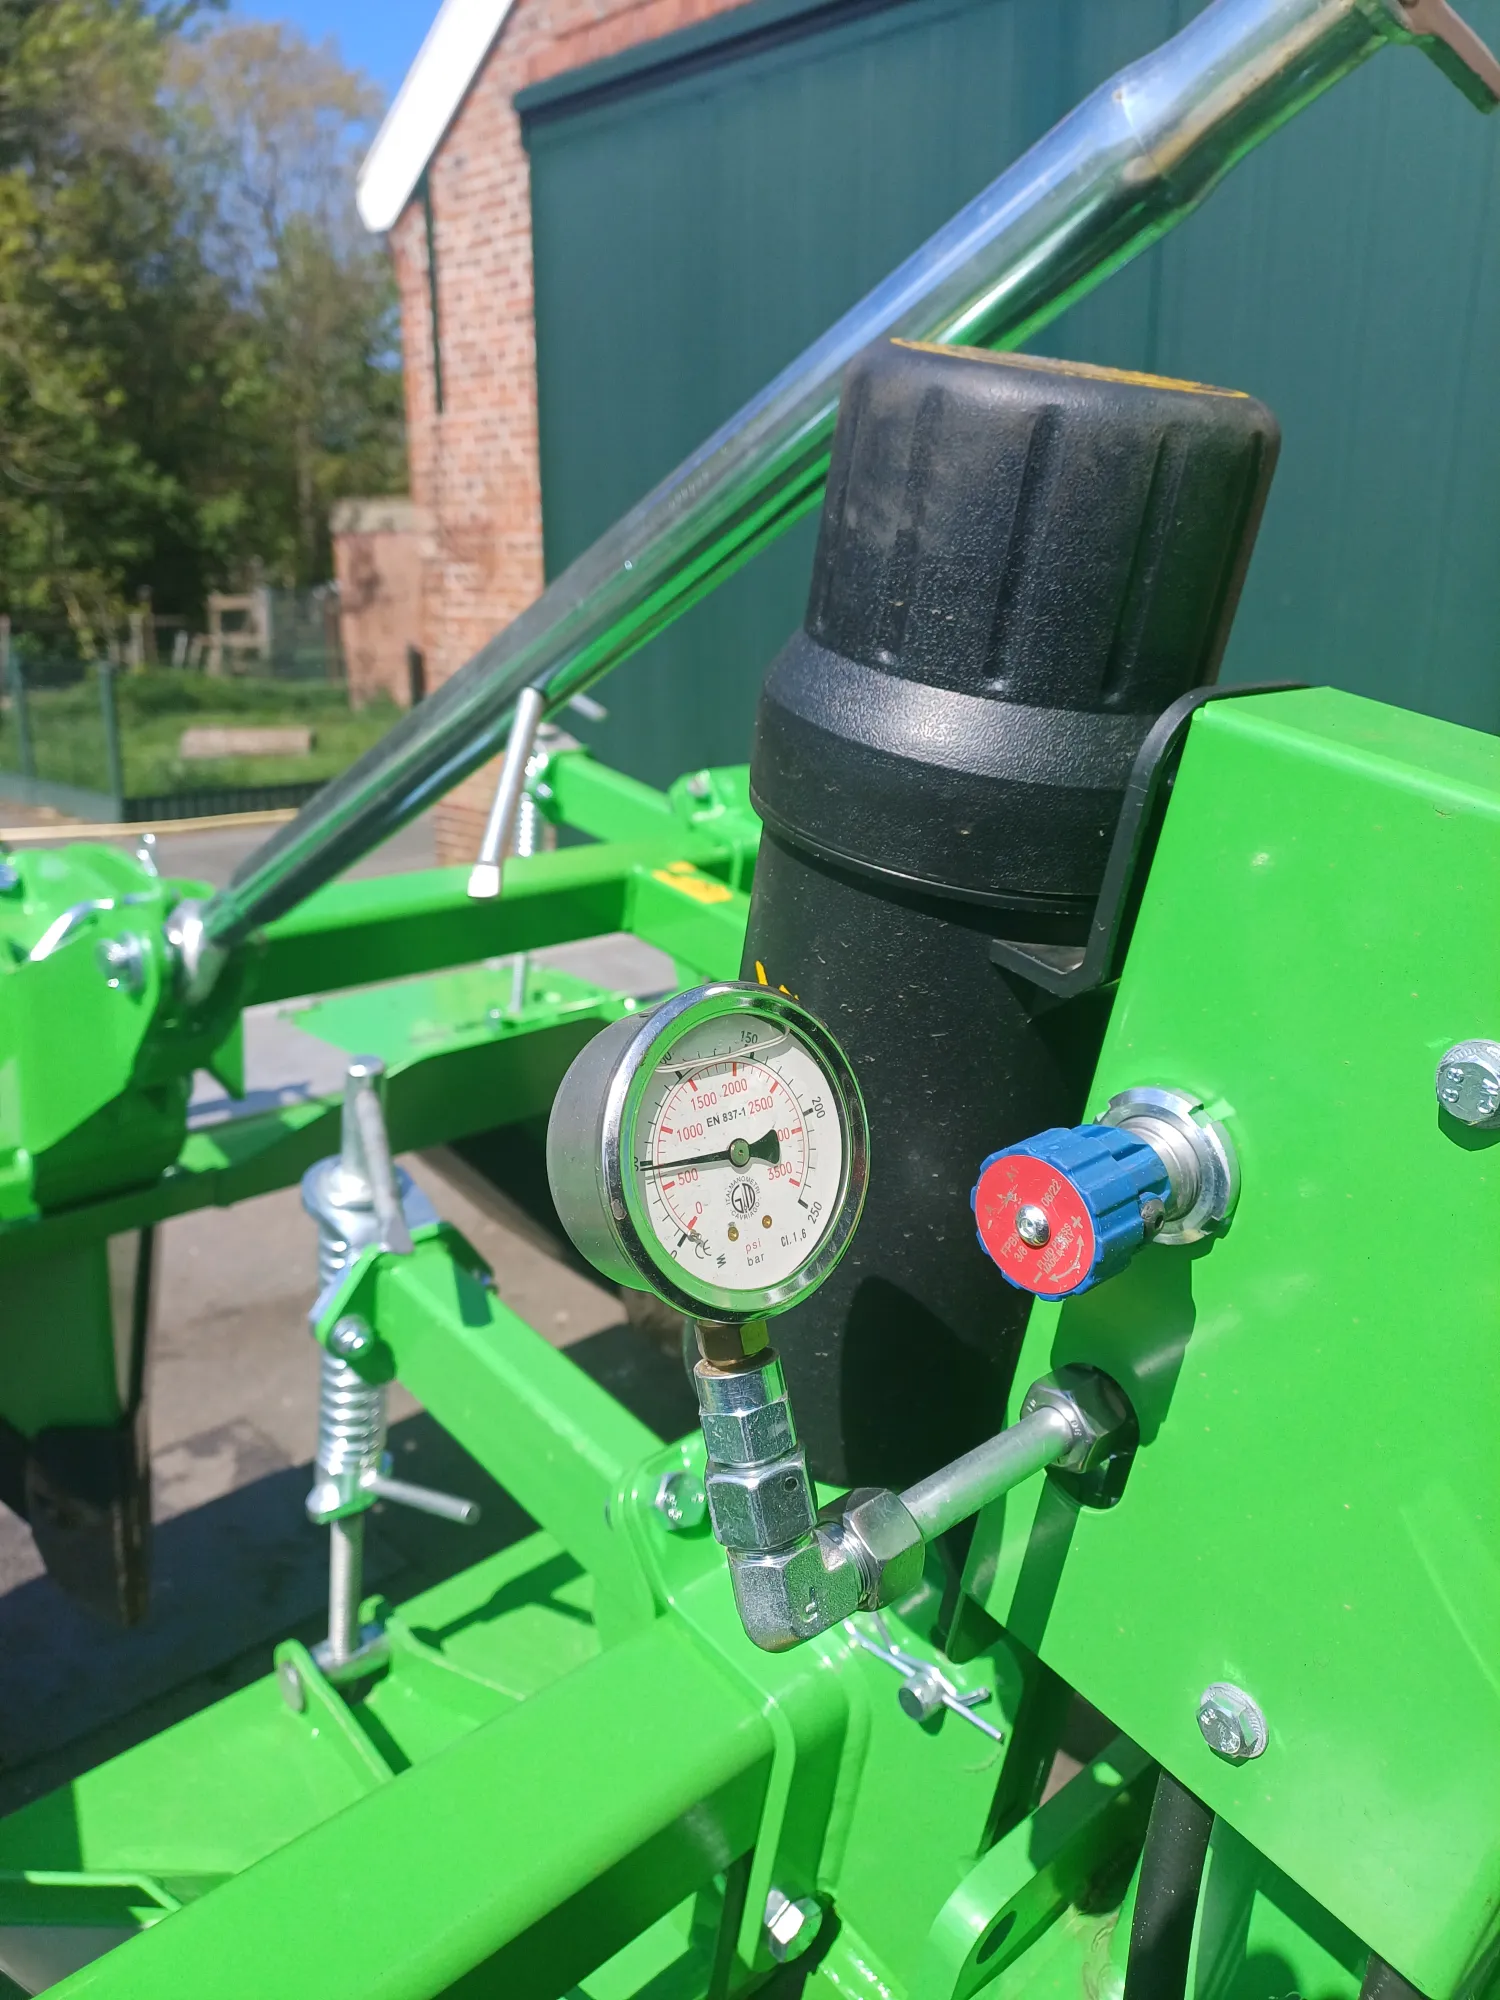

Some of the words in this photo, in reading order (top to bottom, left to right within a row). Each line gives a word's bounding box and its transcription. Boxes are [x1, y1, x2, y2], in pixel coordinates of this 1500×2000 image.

[740, 1030, 758, 1044] 150
[721, 1078, 748, 1097] 2000
[690, 1092, 717, 1111] 1500
[748, 1096, 774, 1115] 2500
[812, 1096, 826, 1119] 200
[706, 1115, 720, 1128] EN
[723, 1108, 746, 1123] 837-1
[677, 1123, 703, 1143] 1000
[677, 1168, 699, 1186] 500
[767, 1161, 792, 1181] 3500
[1041, 1179, 1061, 1207] 06/22
[695, 1201, 703, 1214] 0
[808, 1202, 823, 1224] 250
[745, 1239, 761, 1254] psi
[1014, 1246, 1028, 1262] 3/8
[747, 1253, 765, 1267] bar
[1037, 1248, 1055, 1270] FLUID
